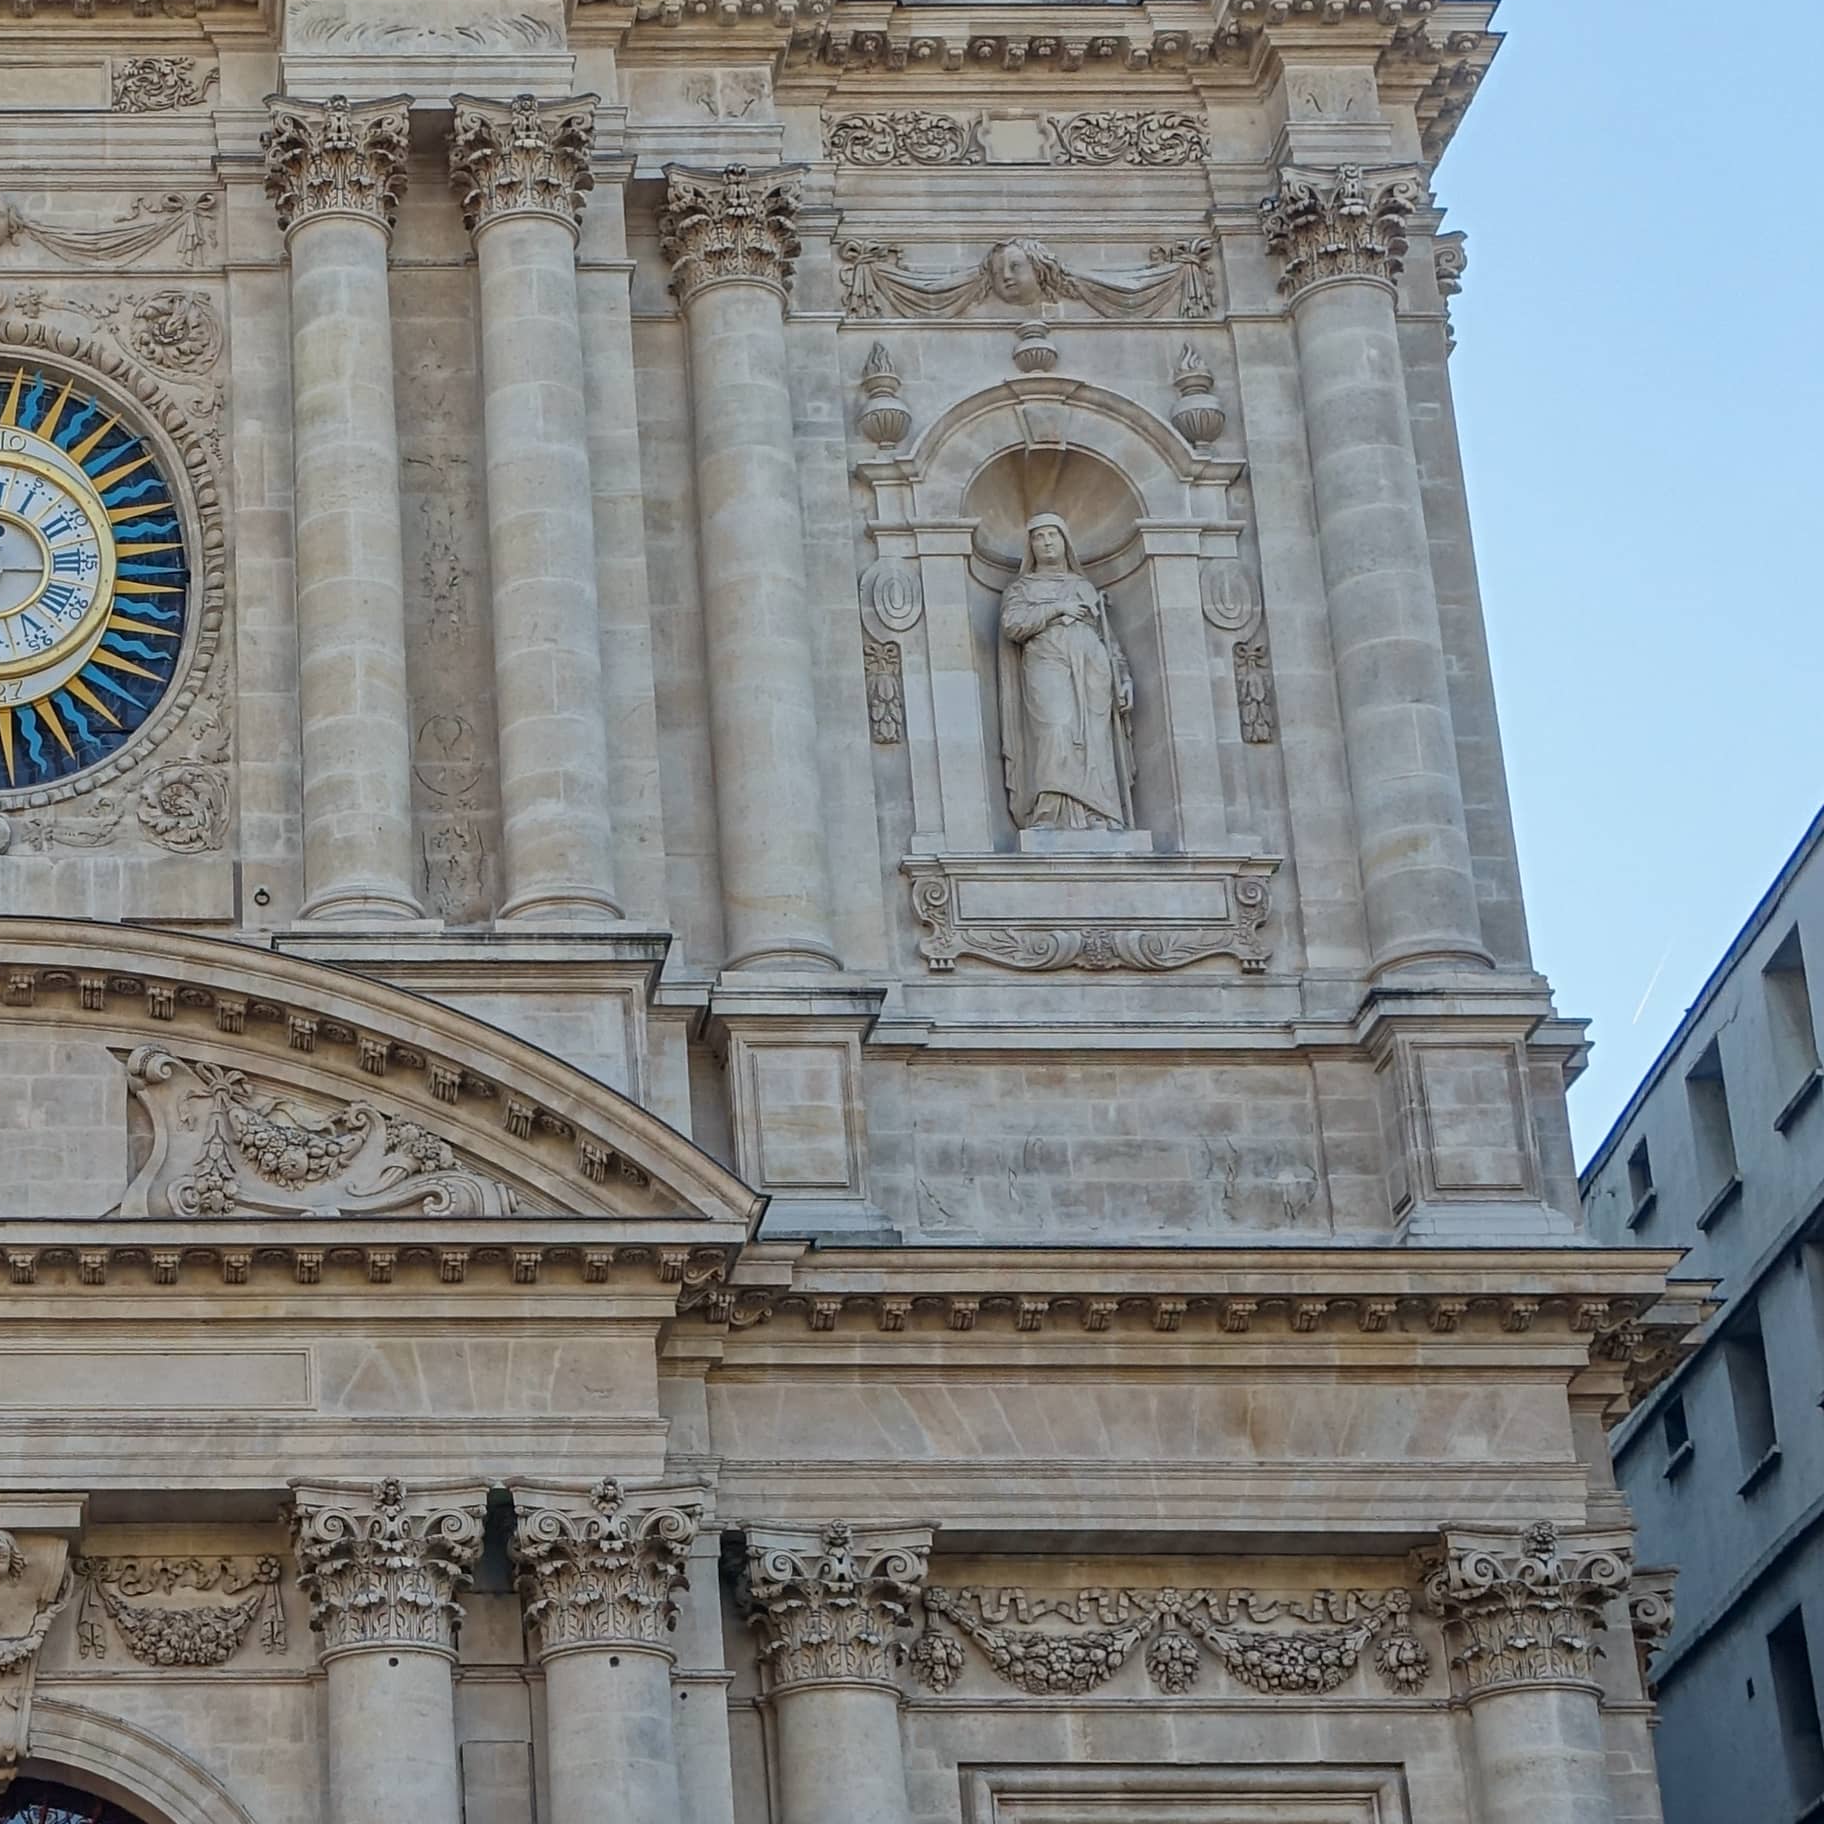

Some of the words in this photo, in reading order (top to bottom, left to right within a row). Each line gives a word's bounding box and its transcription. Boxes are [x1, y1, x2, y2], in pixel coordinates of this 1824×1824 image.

[17, 490, 36, 516] I
[40, 514, 72, 544] II
[70, 508, 88, 527] 10
[52, 548, 80, 575] III
[85, 553, 98, 570] 15
[39, 582, 75, 617] IIII
[69, 598, 89, 620] 20
[20, 613, 43, 637] V
[28, 634, 53, 651] 25
